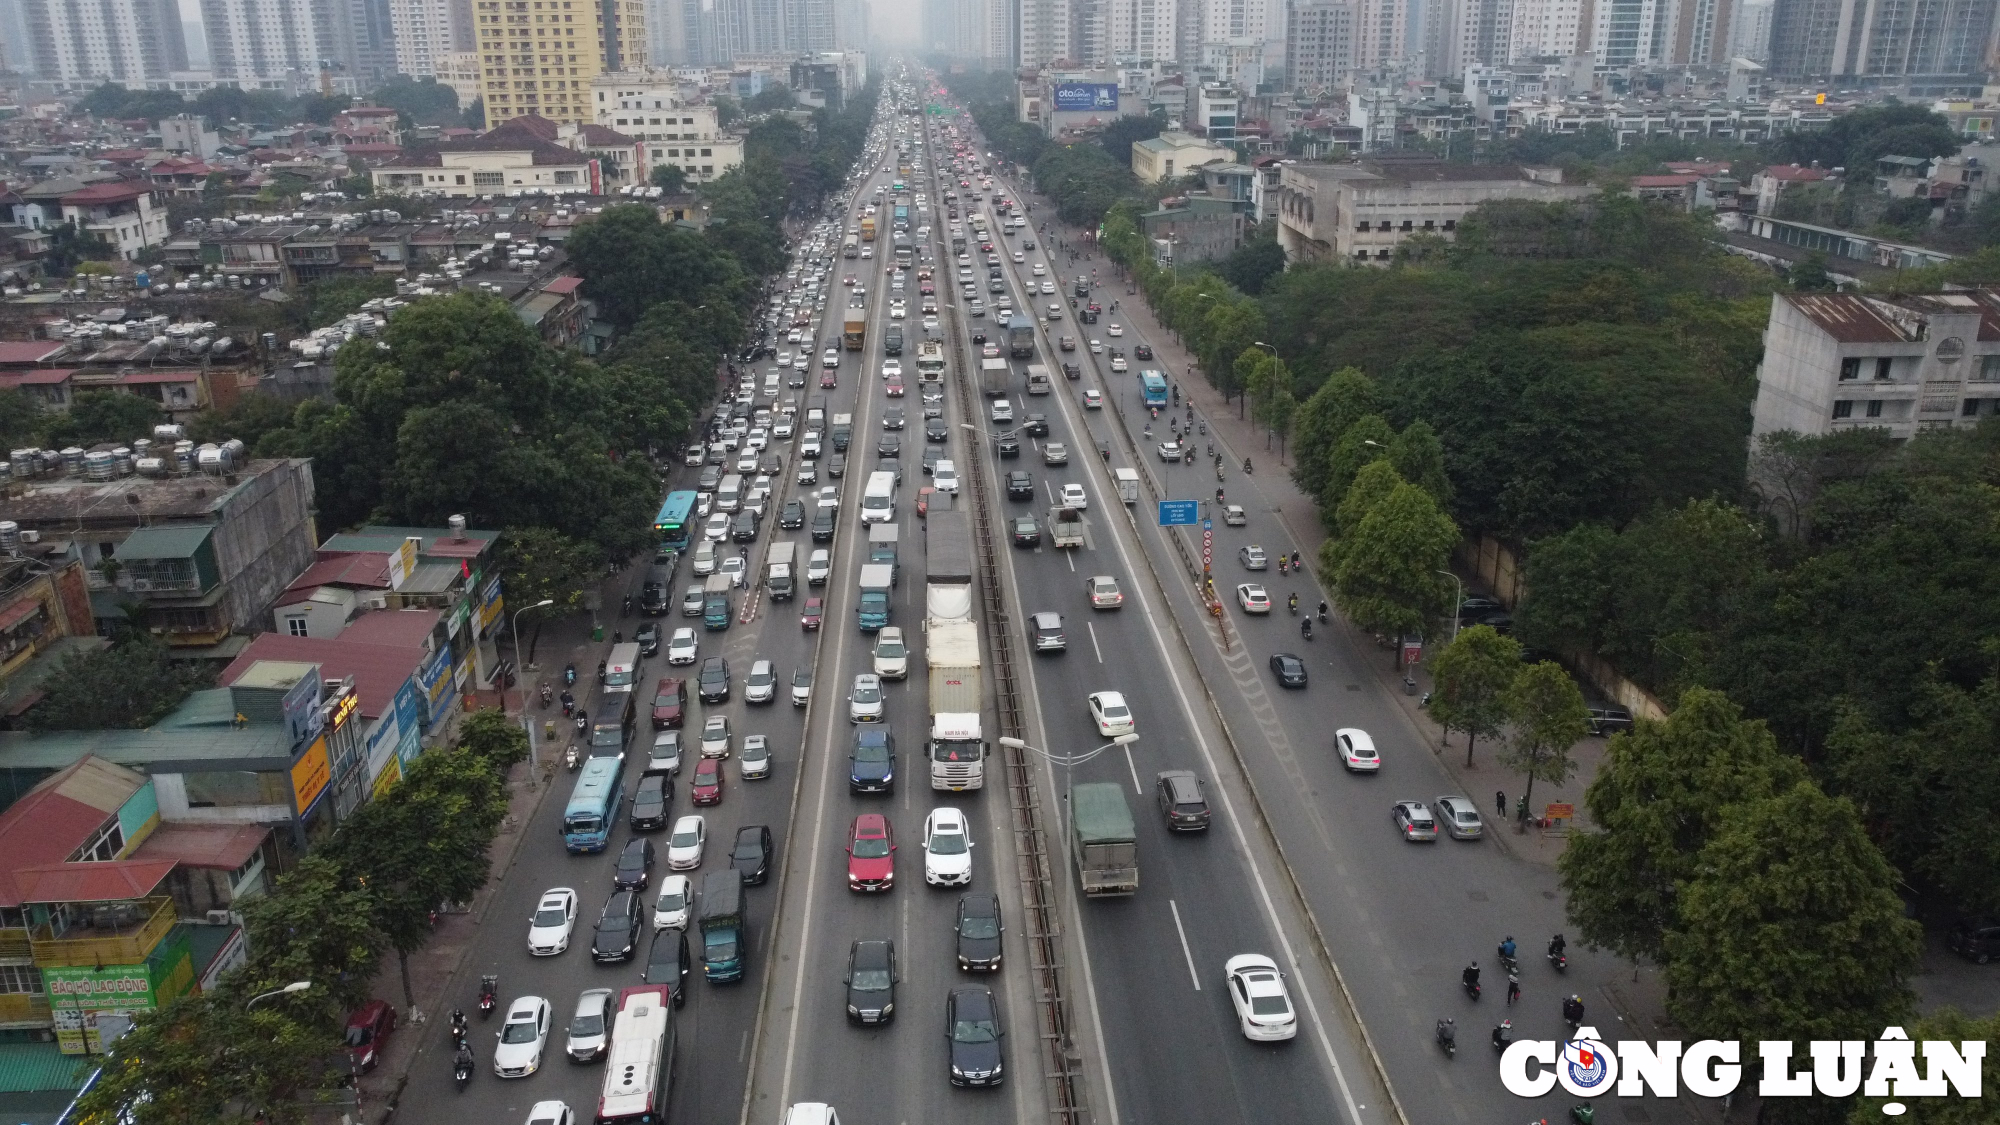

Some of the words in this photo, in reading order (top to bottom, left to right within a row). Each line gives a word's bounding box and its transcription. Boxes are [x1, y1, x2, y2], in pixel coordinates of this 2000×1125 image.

[50, 977, 74, 995] BẢO
[74, 976, 92, 997] HỘ
[92, 979, 115, 993] LAO
[115, 976, 149, 996] ĐỘNG
